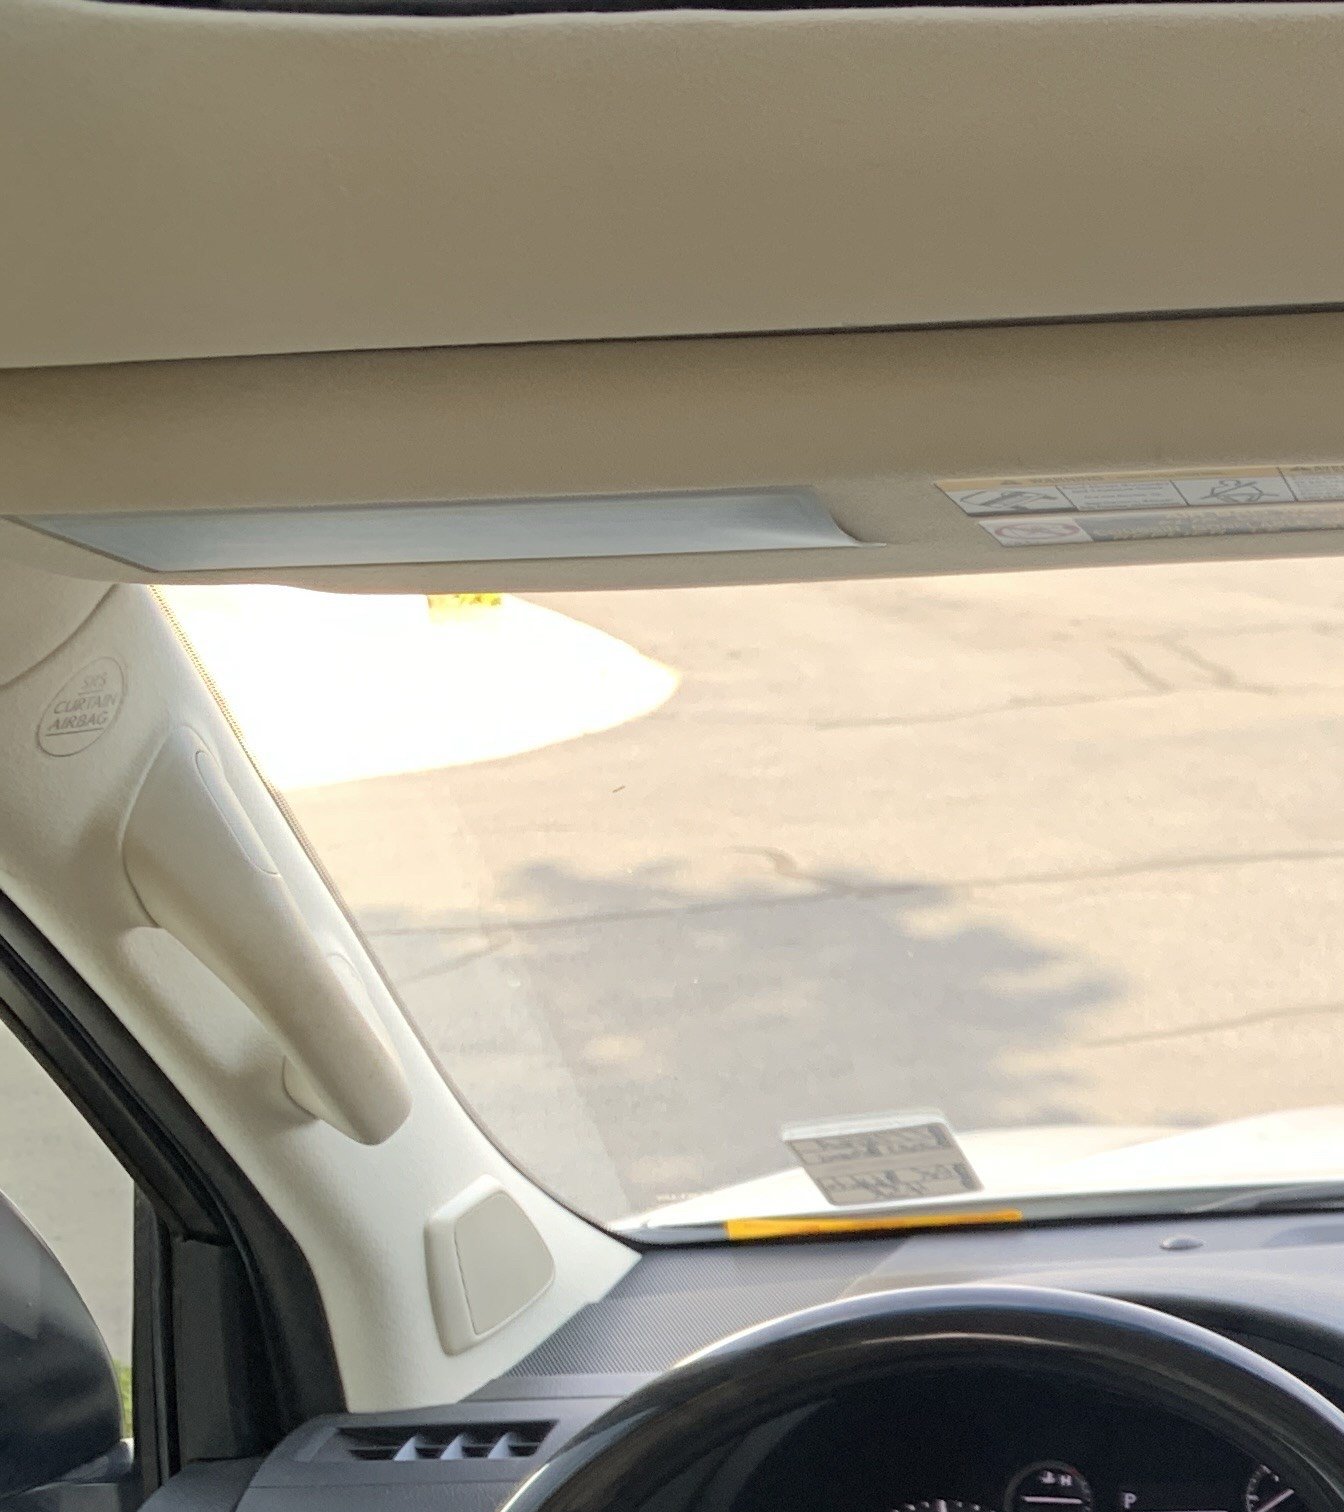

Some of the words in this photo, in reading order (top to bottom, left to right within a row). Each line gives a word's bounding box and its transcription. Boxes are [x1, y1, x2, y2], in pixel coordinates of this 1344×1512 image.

[53, 694, 118, 715] CURTAIN
[49, 710, 109, 732] AIRBAG
[1123, 1493, 1137, 1509] P
